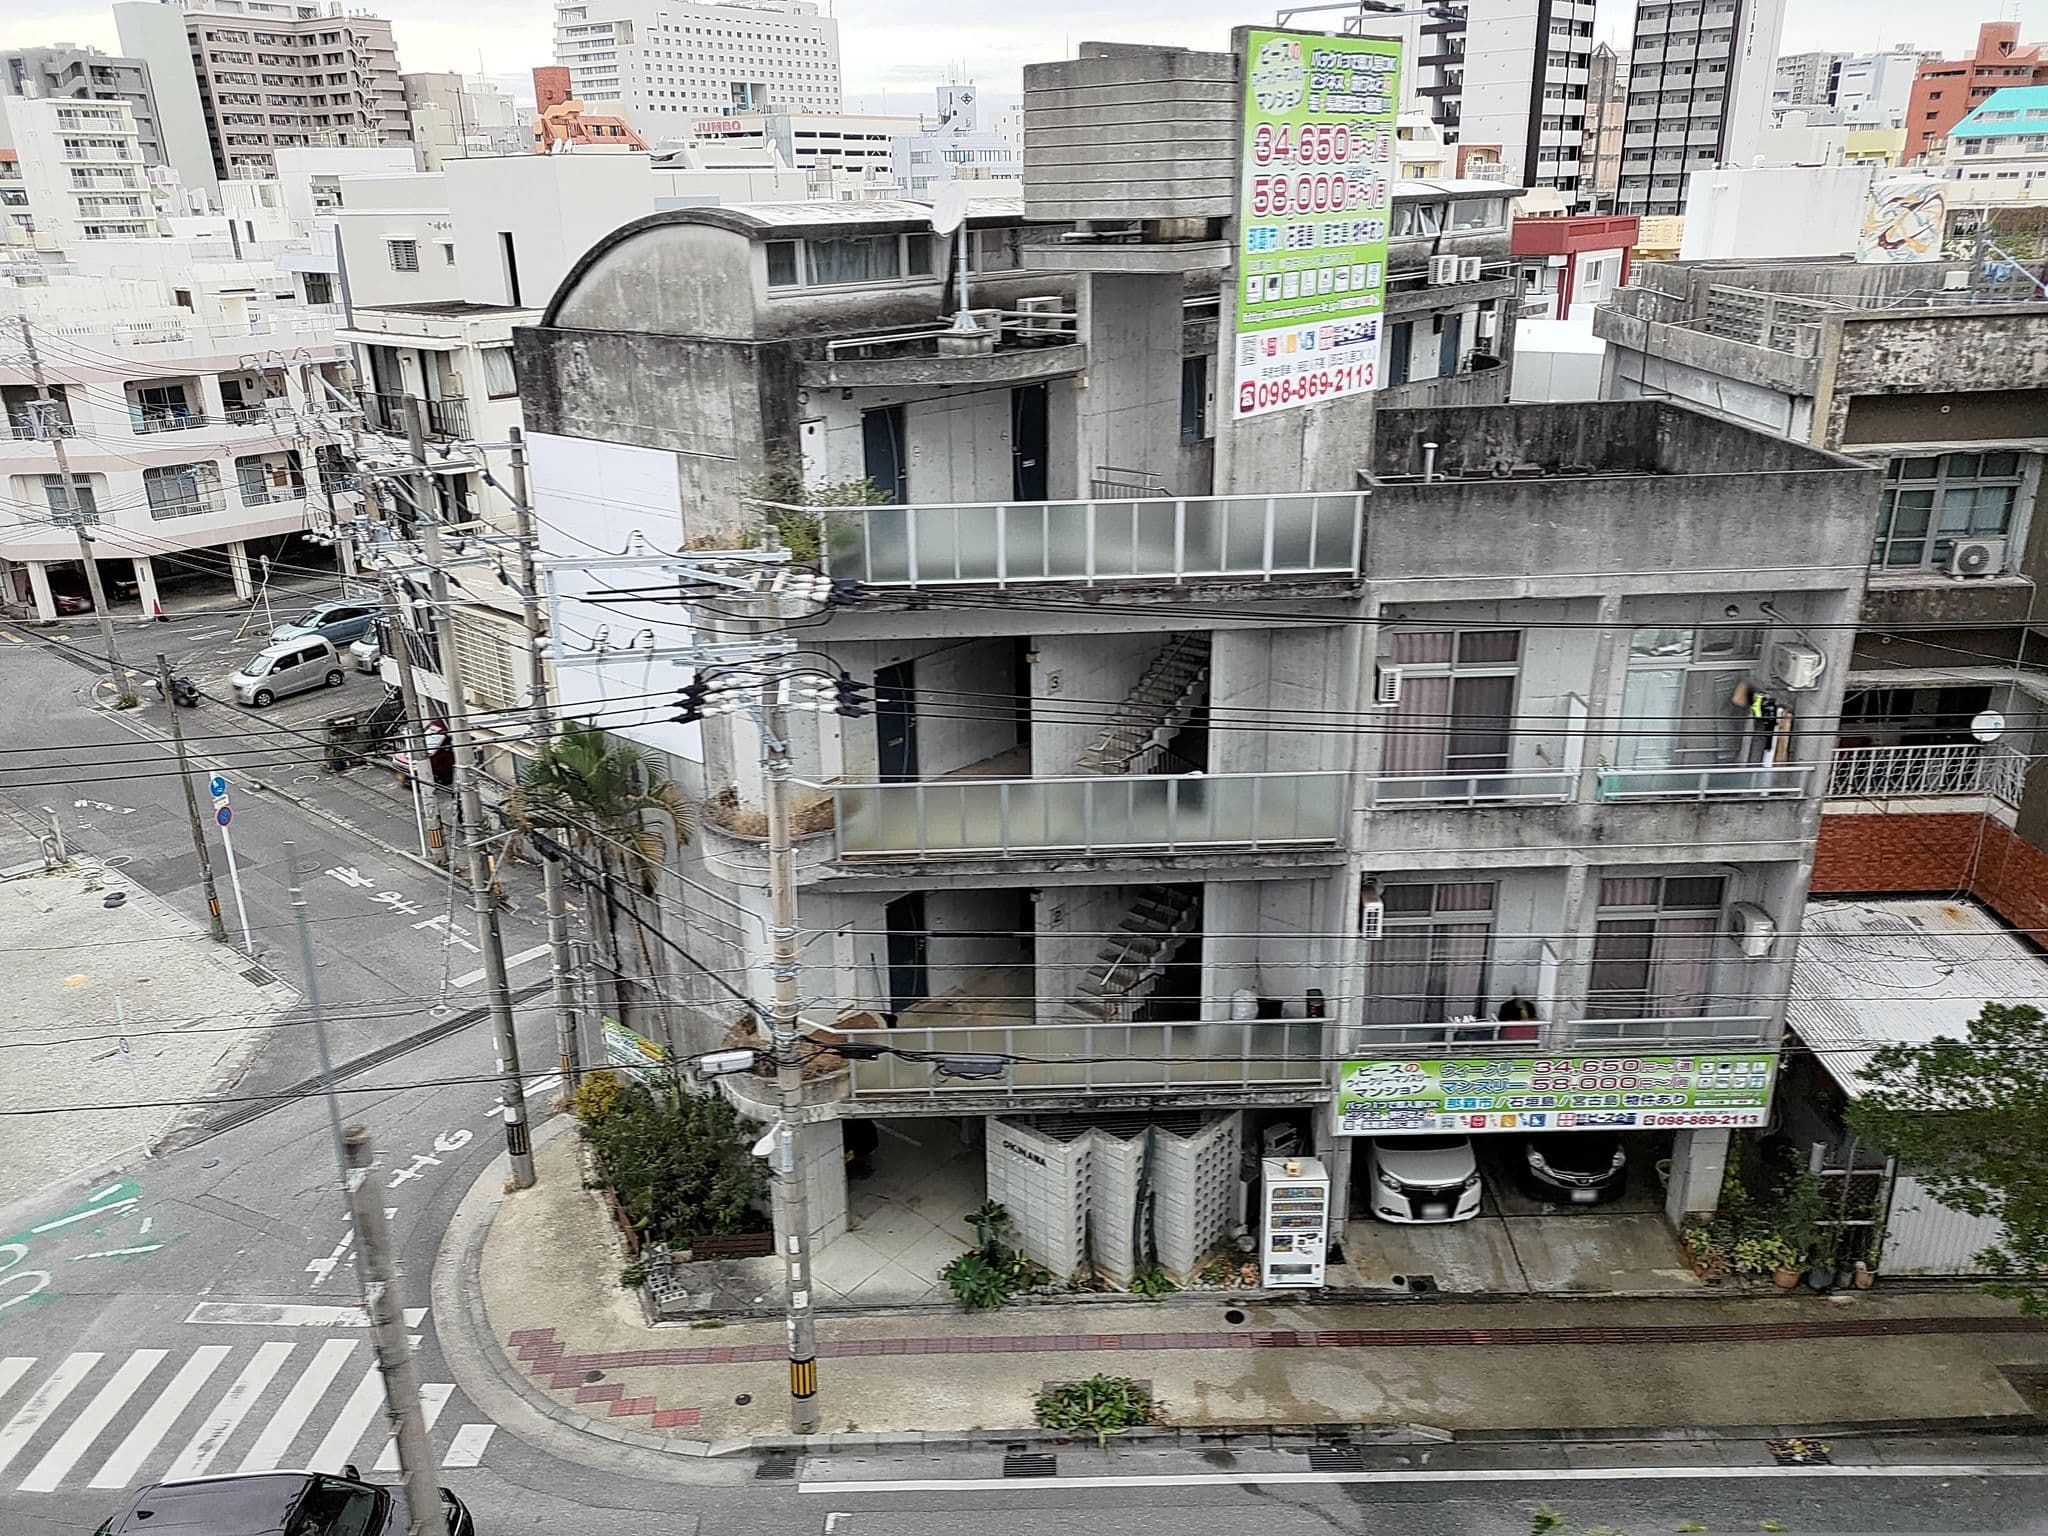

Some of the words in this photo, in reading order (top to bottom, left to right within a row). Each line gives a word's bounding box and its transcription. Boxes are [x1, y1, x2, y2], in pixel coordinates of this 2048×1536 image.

[693, 120, 741, 133] JUMBO
[1258, 362, 1374, 407] 098-869-2113
[1050, 675, 1060, 689] 3
[1441, 1062, 1529, 1076] ウィークリー
[1356, 1084, 1426, 1098] マンション
[1440, 1079, 1528, 1095] マンスリー
[1624, 1094, 1686, 1106] 物件あり
[1658, 1115, 1759, 1126] 098-869-2113
